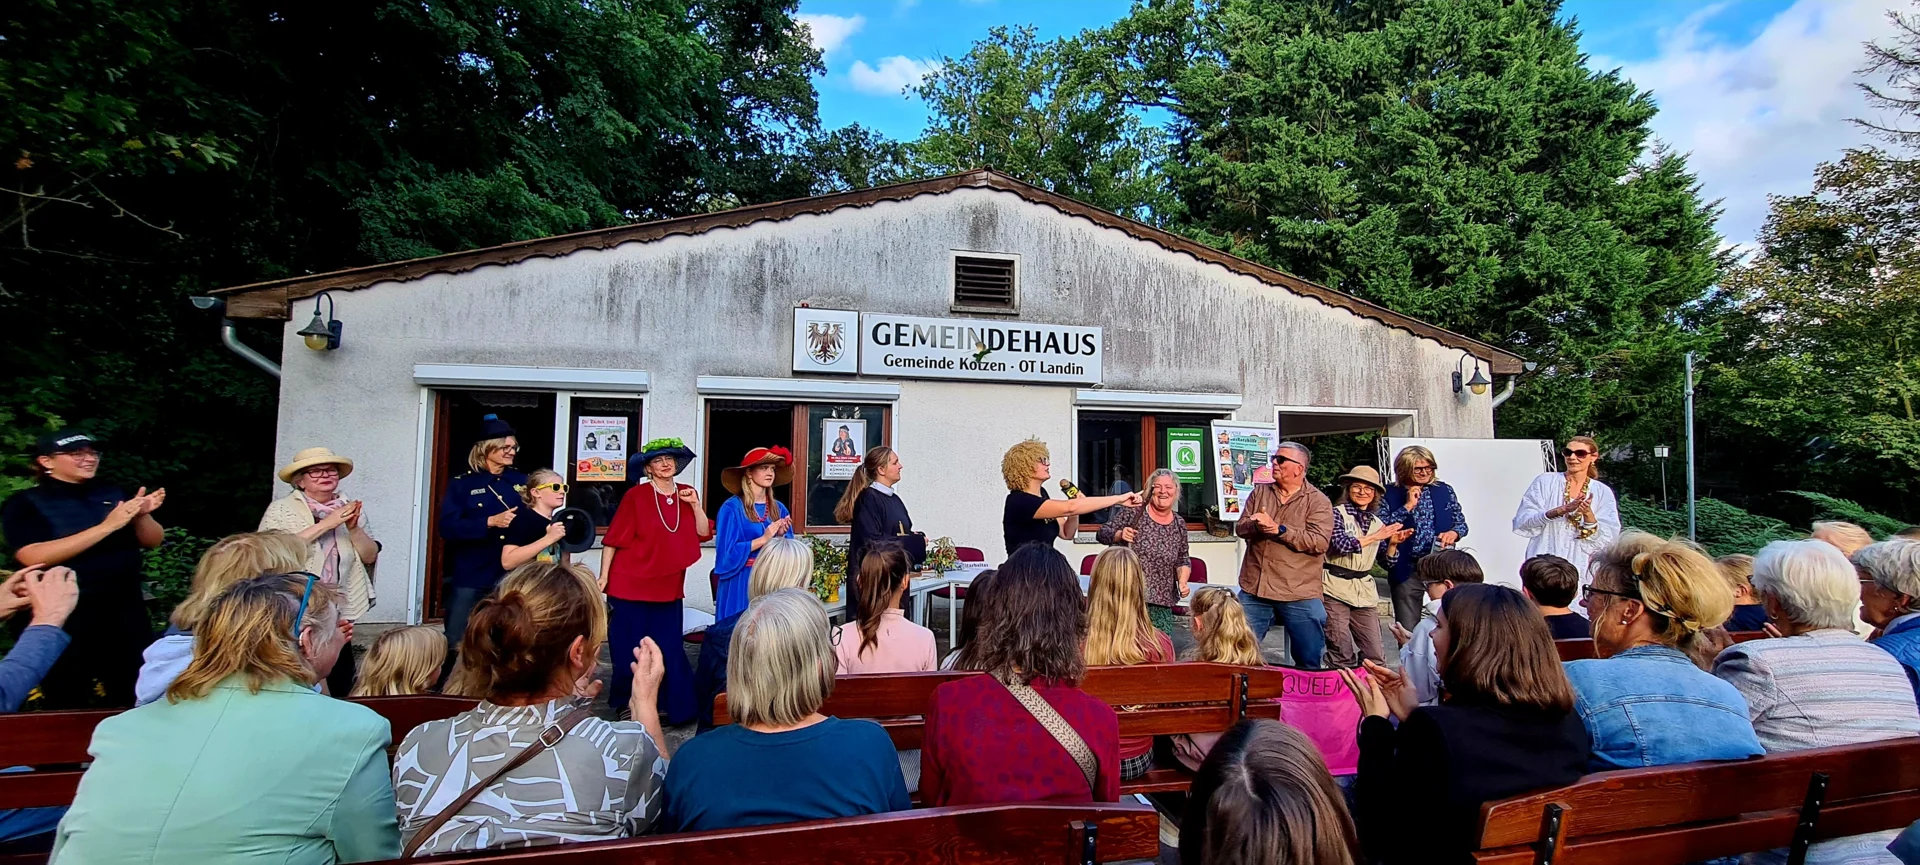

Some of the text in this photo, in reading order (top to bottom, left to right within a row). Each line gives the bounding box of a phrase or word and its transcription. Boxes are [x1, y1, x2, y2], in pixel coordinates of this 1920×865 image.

[872, 322, 1096, 356] GEMEINDEHAUS
[883, 354, 954, 370] Gemeinde
[1018, 360, 1036, 373] OT
[1040, 361, 1084, 375] Landin
[1181, 451, 1190, 462] K
[1282, 674, 1343, 696] QUEEN
